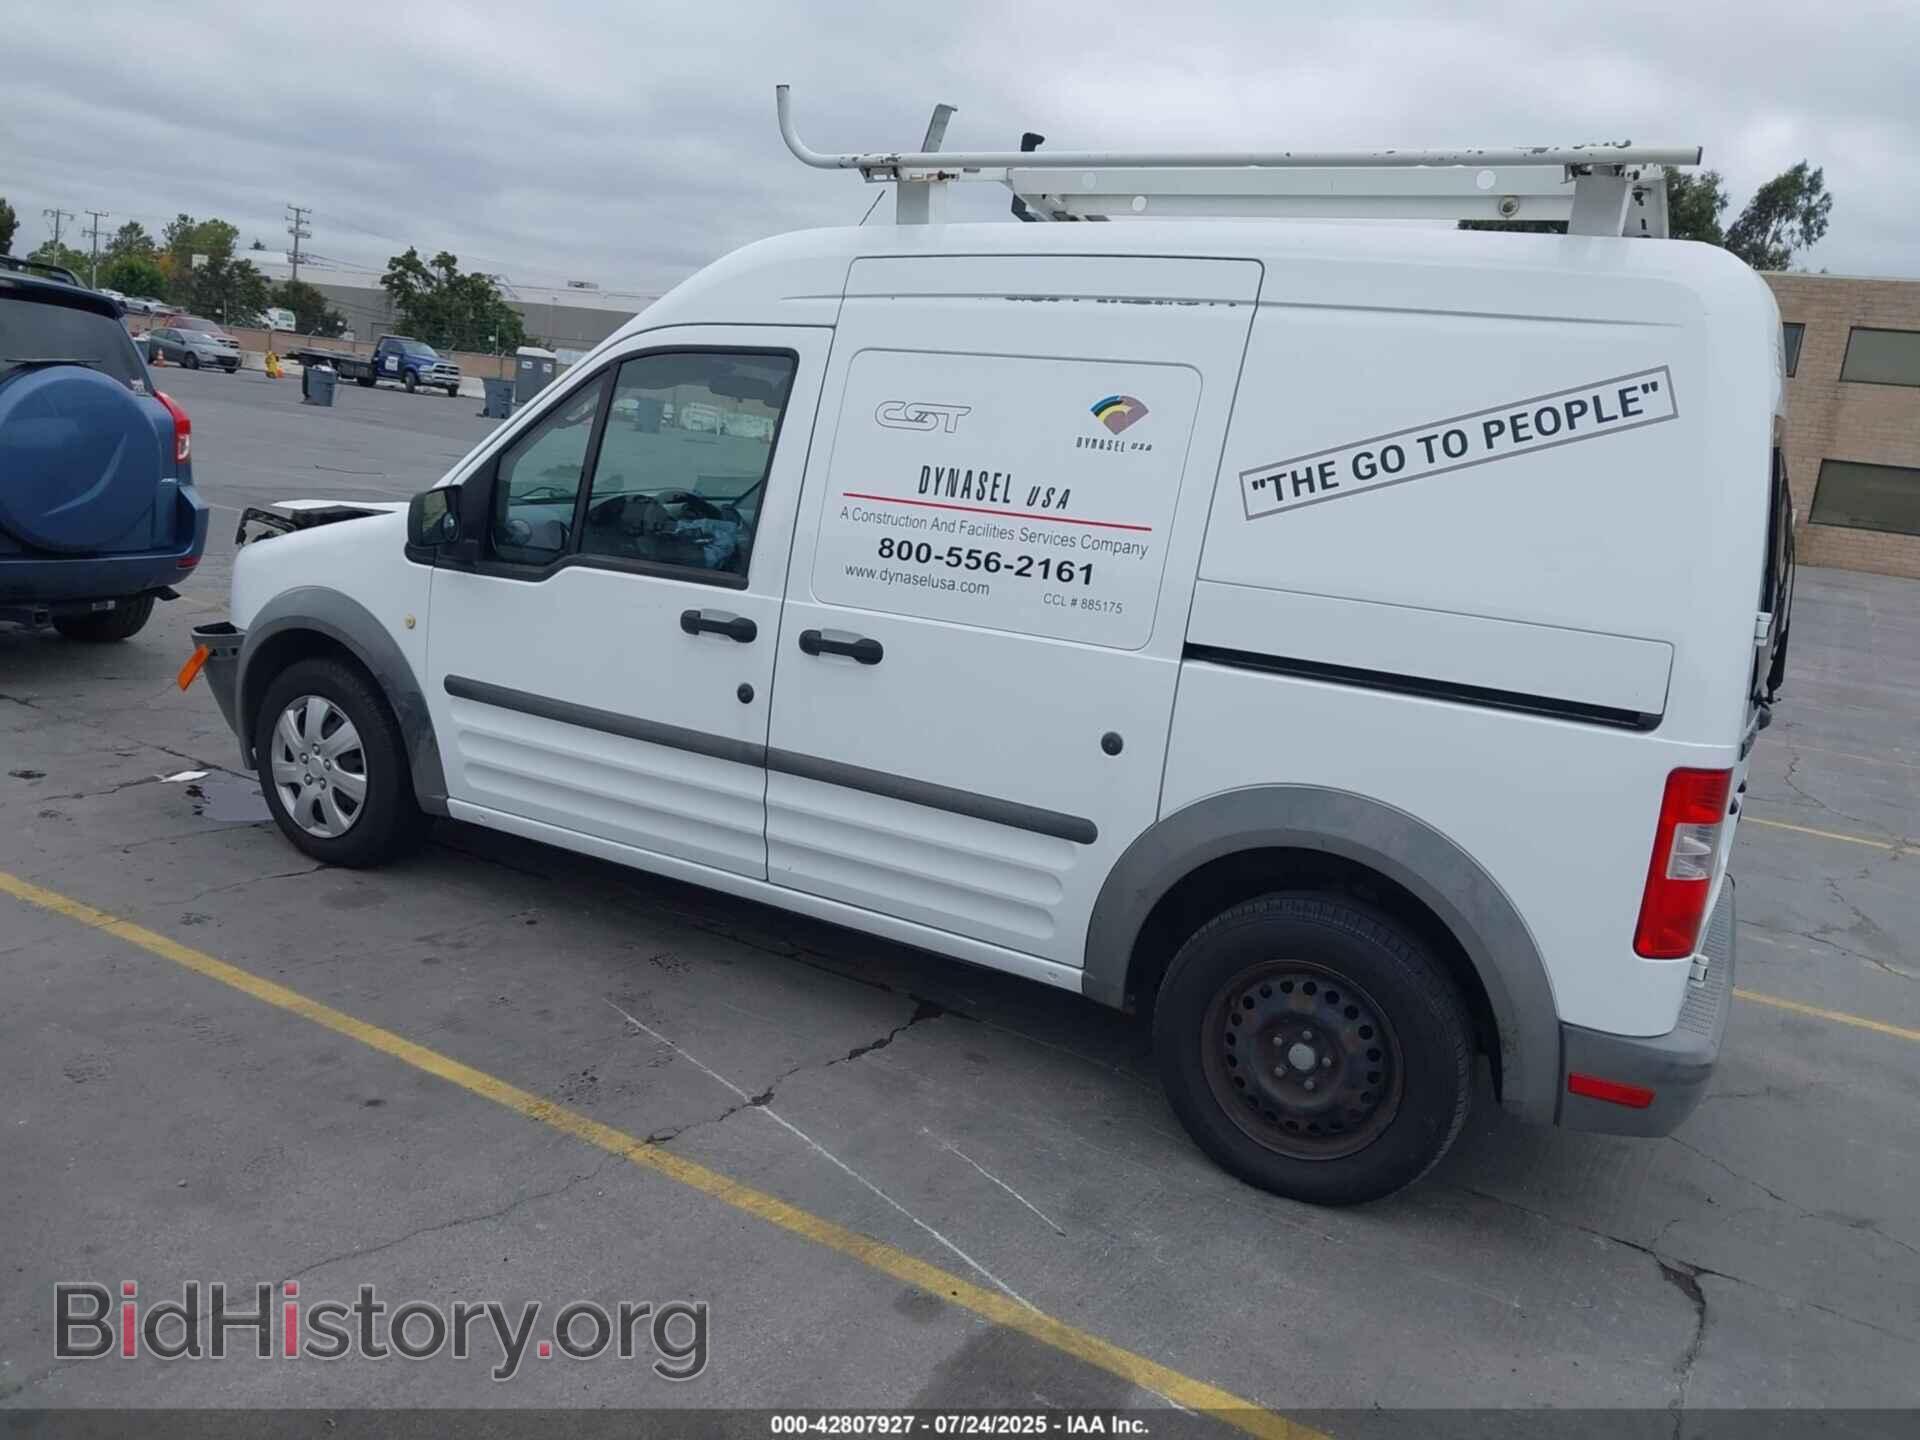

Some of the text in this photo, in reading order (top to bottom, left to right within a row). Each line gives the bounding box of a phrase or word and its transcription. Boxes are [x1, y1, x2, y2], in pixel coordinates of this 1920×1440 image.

[1076, 436, 1152, 452] DYNASEL USA
[1351, 444, 1406, 480] GO
[1417, 429, 1469, 465] TO
[918, 465, 1072, 510] DYNASEL USA
[840, 506, 1149, 560] A Construction And Facilities Services Company
[845, 564, 990, 596] www.dynaselusa.com
[877, 537, 1095, 586] 800-556-2161
[1043, 593, 1123, 614] CCL # 885175
